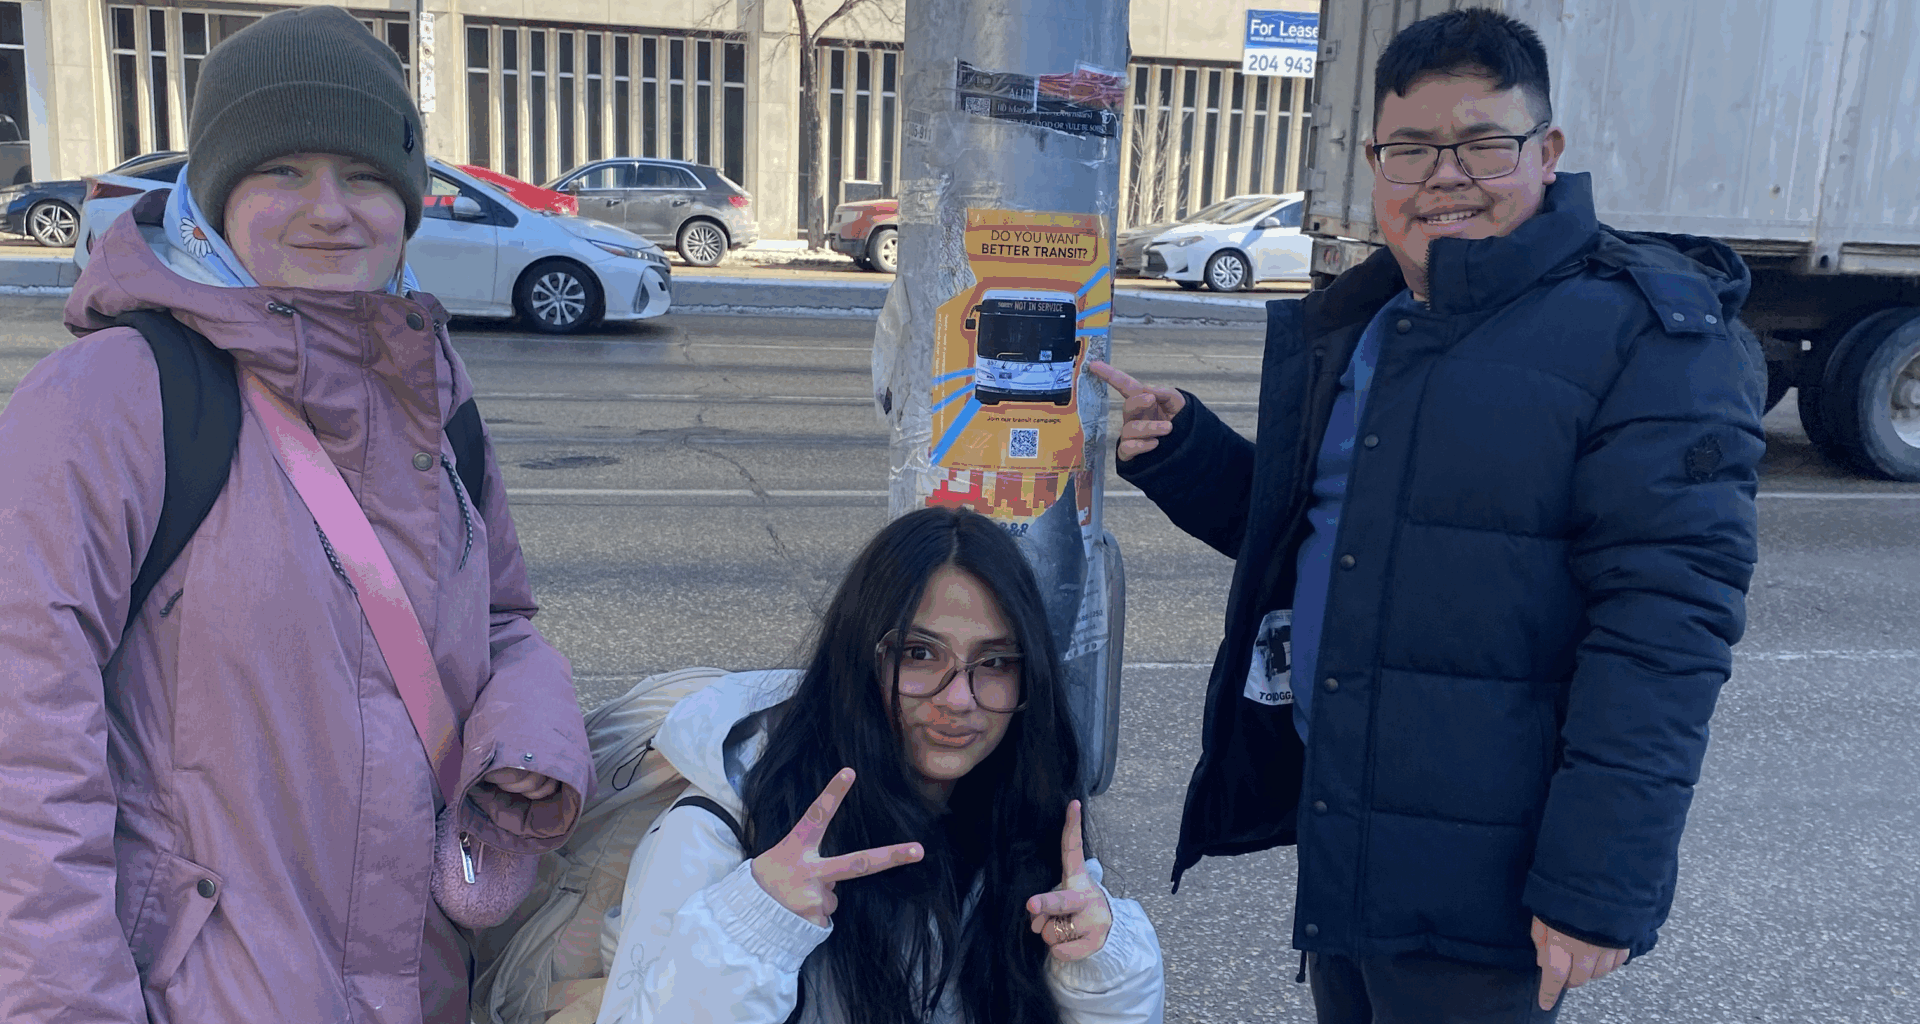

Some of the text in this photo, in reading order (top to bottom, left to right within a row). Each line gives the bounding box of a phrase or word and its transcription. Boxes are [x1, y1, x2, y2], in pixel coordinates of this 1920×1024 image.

[1250, 19, 1319, 38] For Lease
[1248, 54, 1314, 74] 204 943
[991, 229, 1080, 245] DO YOU WANT
[981, 243, 1088, 259] BETTER TRANSIT?
[1014, 301, 1027, 311] NOT
[1028, 302, 1037, 311] IN
[1037, 302, 1064, 312] SERVICE
